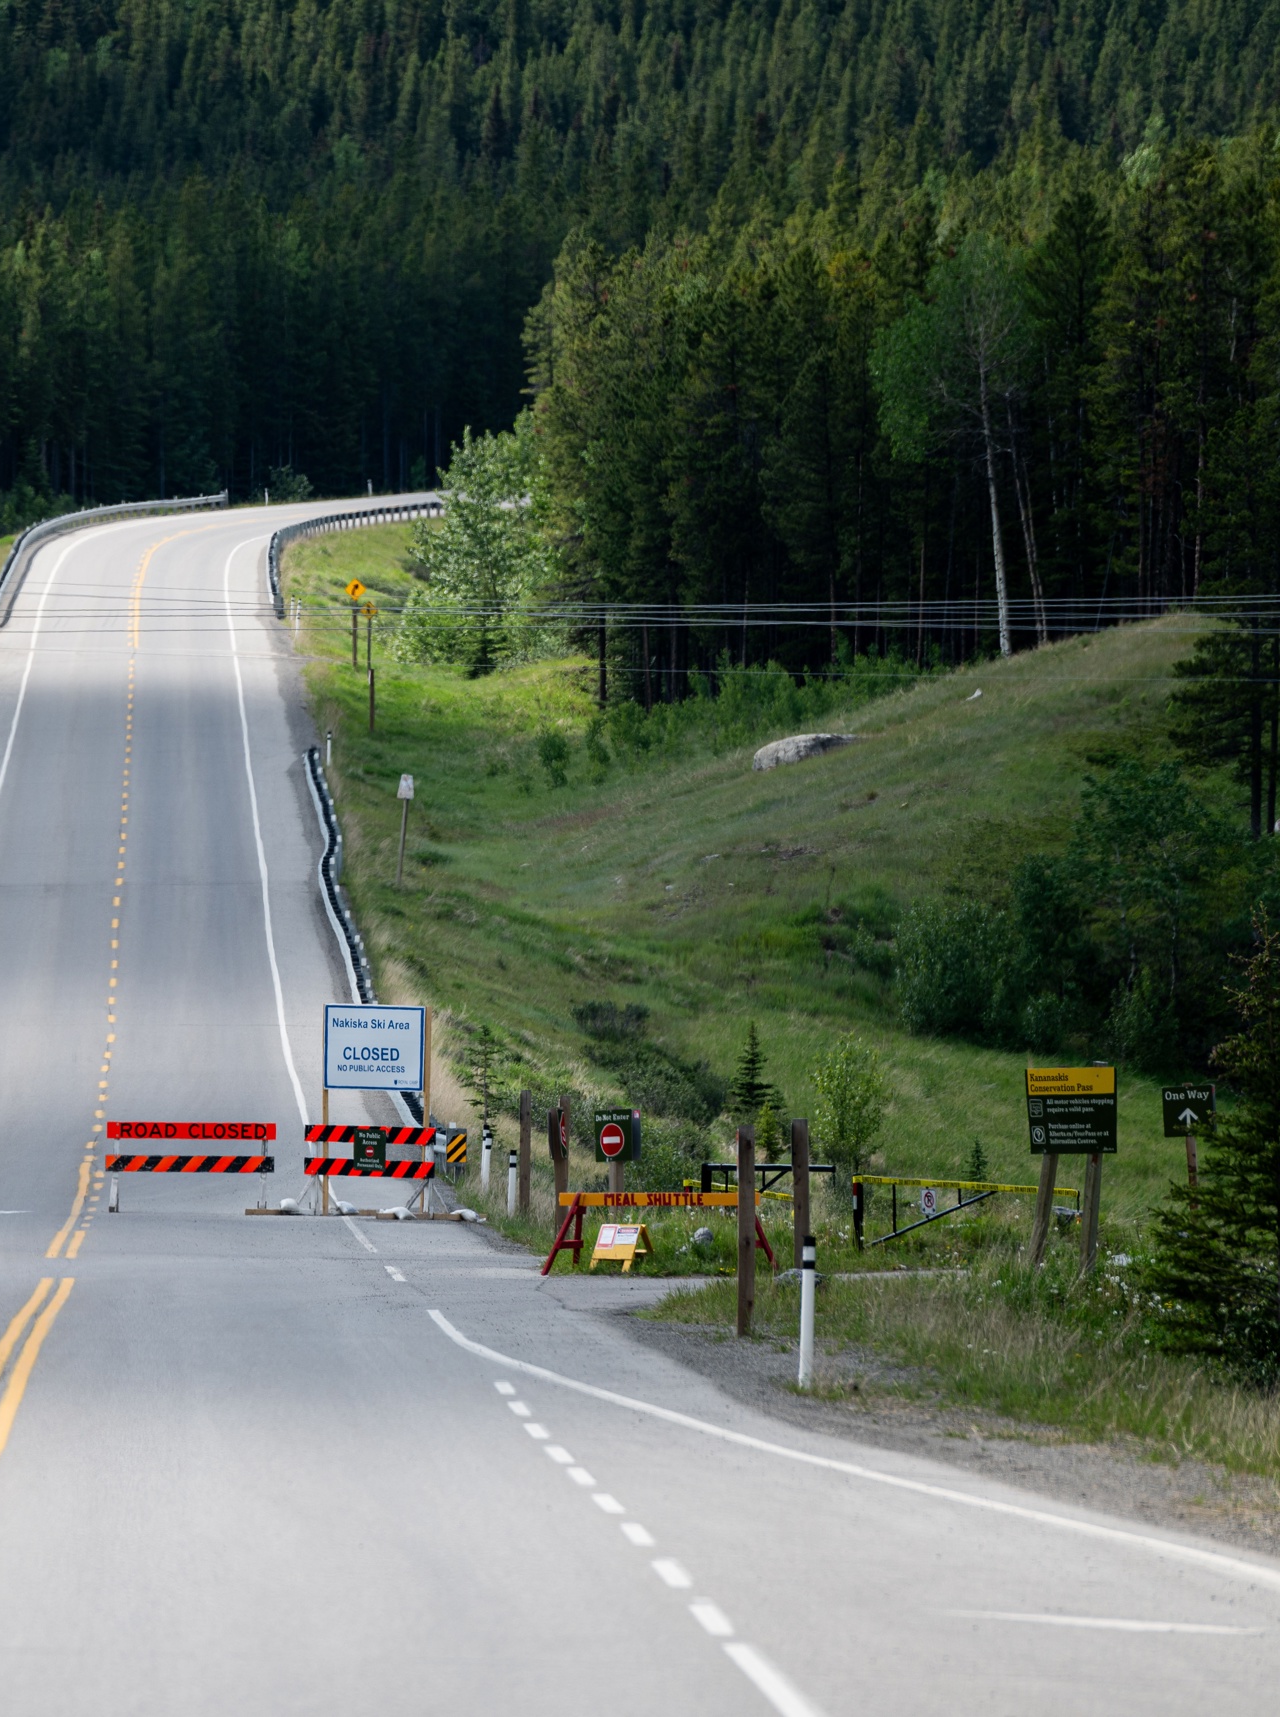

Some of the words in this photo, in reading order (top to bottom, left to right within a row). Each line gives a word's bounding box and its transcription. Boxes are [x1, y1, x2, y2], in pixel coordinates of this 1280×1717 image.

[332, 1018, 368, 1029] Nakiska
[371, 1019, 386, 1029] Ski
[388, 1020, 410, 1030] Area
[343, 1047, 400, 1061] CLOSED
[349, 1065, 374, 1073] PUBLIC
[1029, 1073, 1069, 1082] Kananaskis
[1030, 1083, 1075, 1092] Conservation
[1077, 1083, 1094, 1092] Pass
[1164, 1091, 1185, 1101] One
[1187, 1090, 1209, 1101] Way
[1090, 1098, 1114, 1106] stopping
[595, 1114, 602, 1122] Do
[612, 1113, 629, 1121] Enter
[119, 1122, 178, 1138] ROAD
[188, 1123, 267, 1139] CLOSED
[604, 1193, 637, 1206] MEAL
[646, 1193, 703, 1206] SHUTTLE
